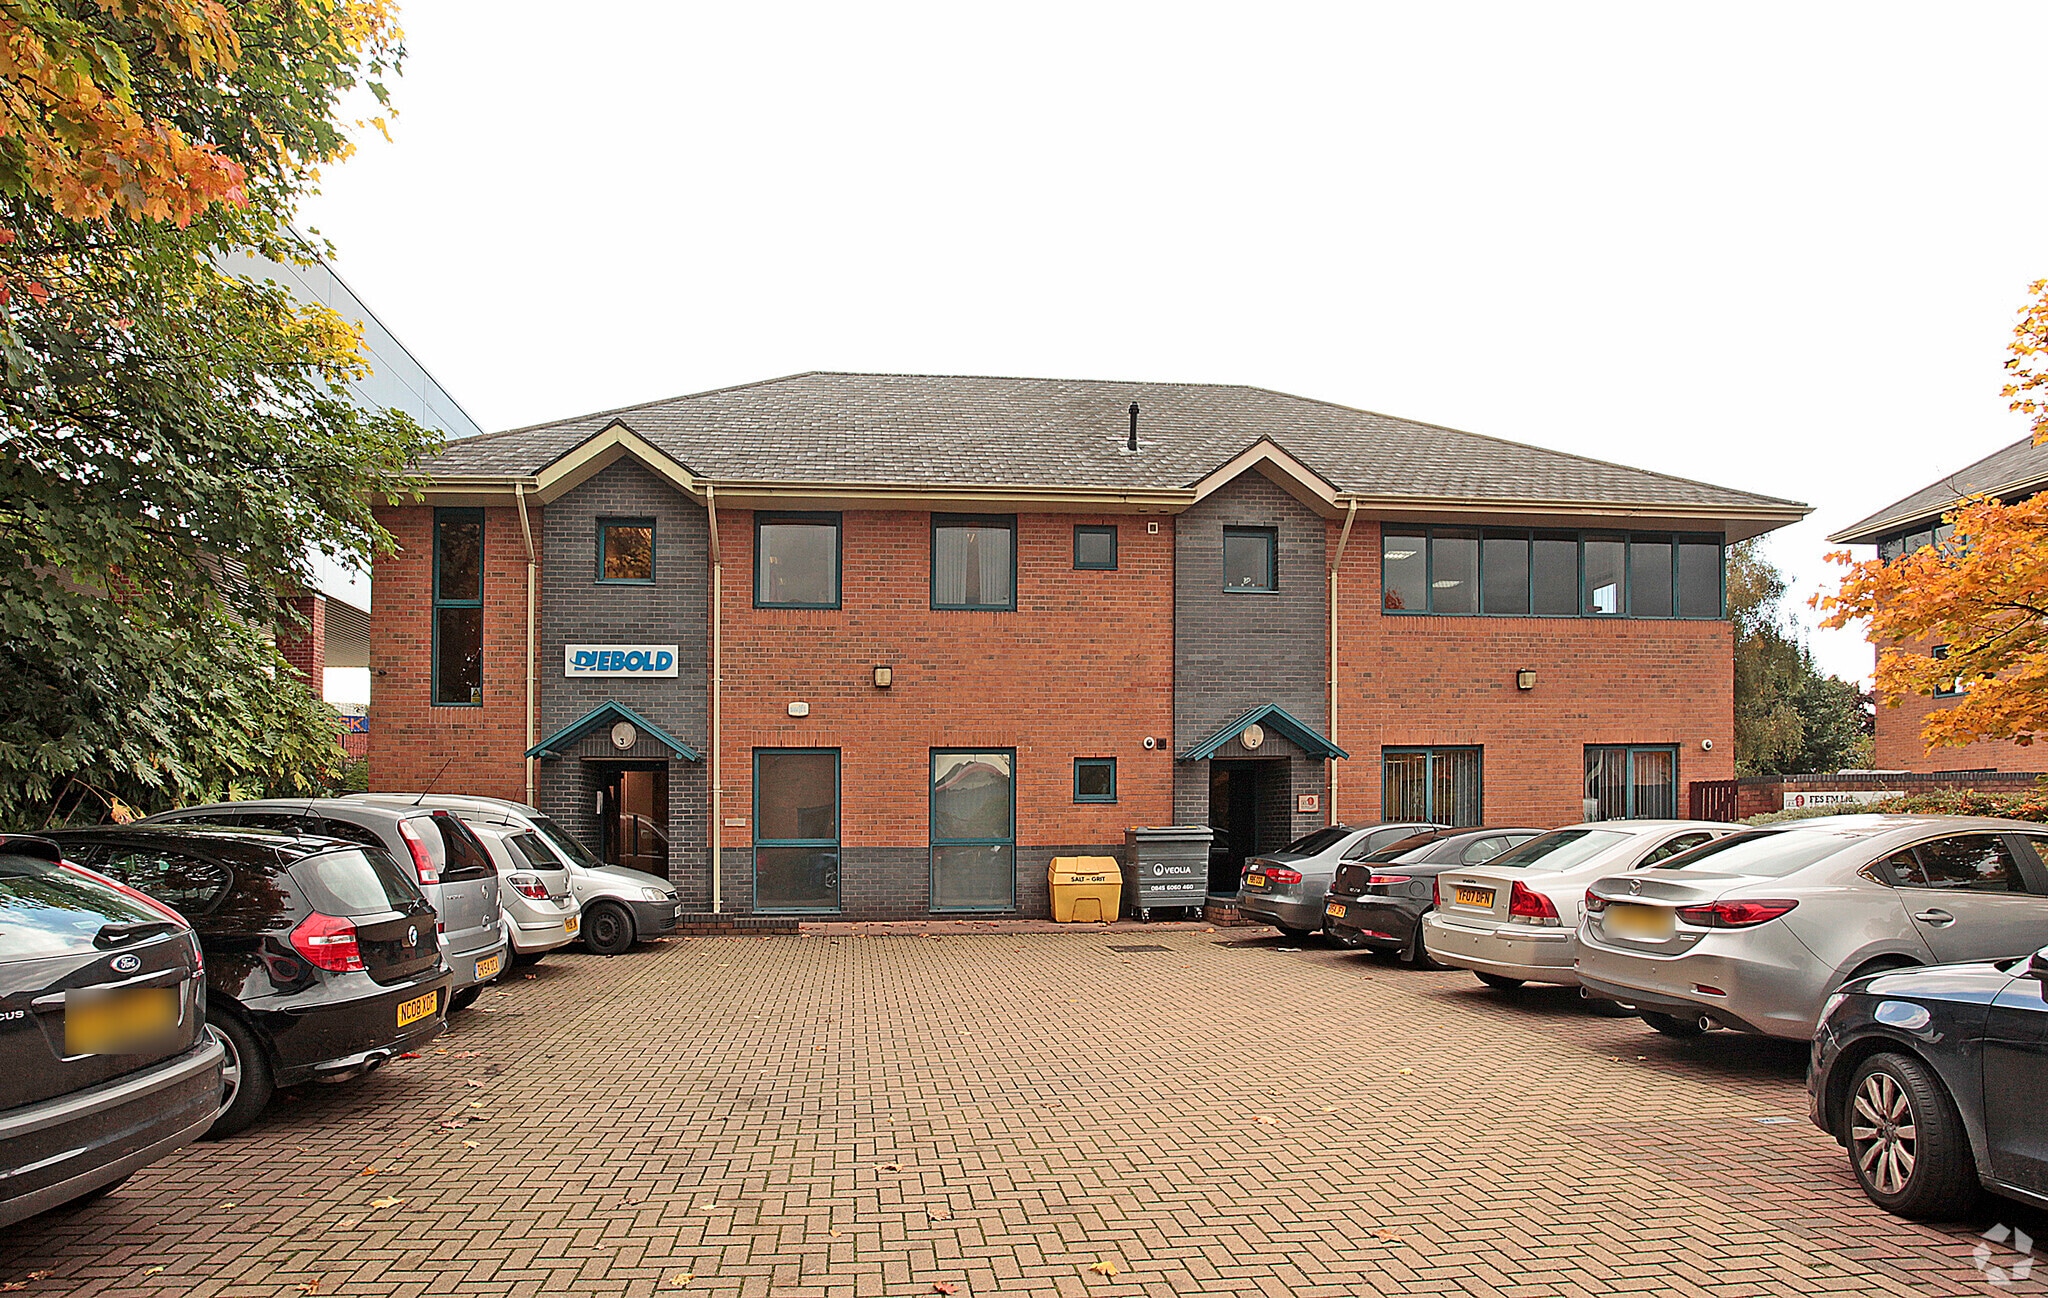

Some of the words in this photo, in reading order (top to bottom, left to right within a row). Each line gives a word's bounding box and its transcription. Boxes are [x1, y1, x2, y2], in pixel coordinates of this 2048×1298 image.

[572, 650, 674, 671] DIEBOLD
[619, 737, 625, 745] 3
[1251, 738, 1257, 746] 2
[1809, 795, 1825, 804] FES
[1825, 795, 1839, 804] FM
[1164, 866, 1191, 874] VEOLIA
[1458, 889, 1476, 902] YF07
[120, 957, 136, 969] Ford
[401, 999, 421, 1022] NC08
